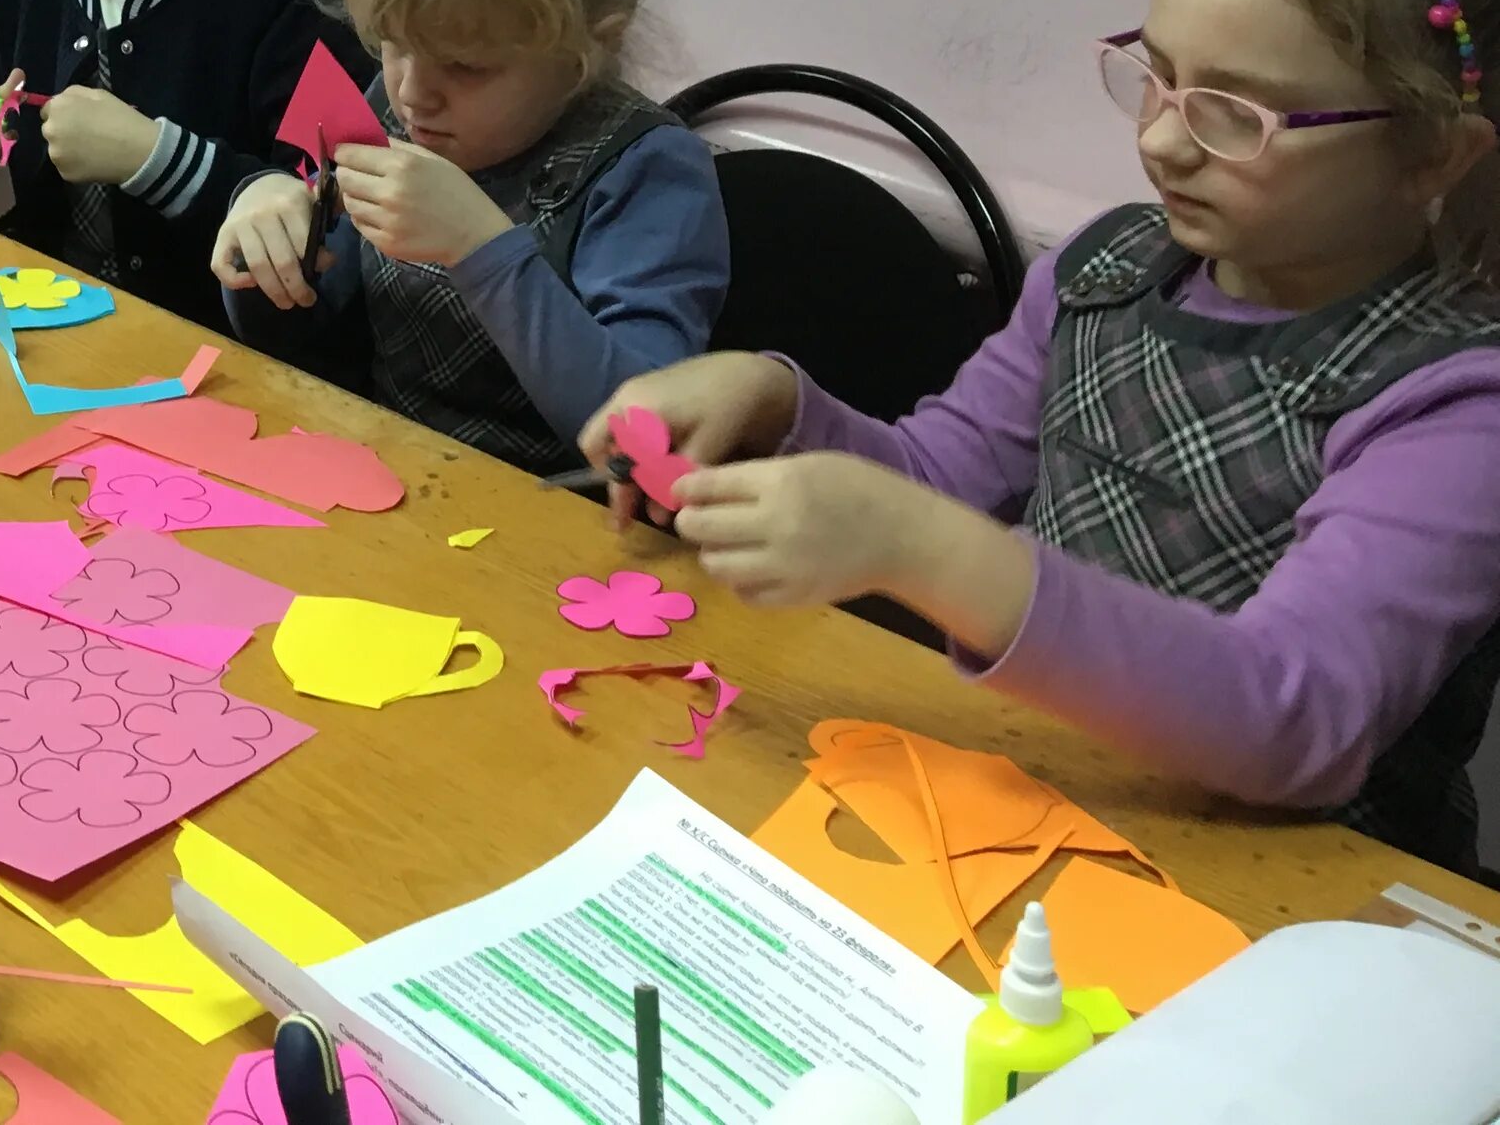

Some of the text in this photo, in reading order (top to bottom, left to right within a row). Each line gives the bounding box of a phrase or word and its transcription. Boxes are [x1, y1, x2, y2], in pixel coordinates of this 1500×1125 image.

[705, 838, 743, 866] Сценка
[740, 862, 770, 884] «Что
[766, 880, 820, 920] подарить
[817, 917, 833, 929] на
[830, 925, 847, 939] 23
[842, 935, 898, 976] февраля»
